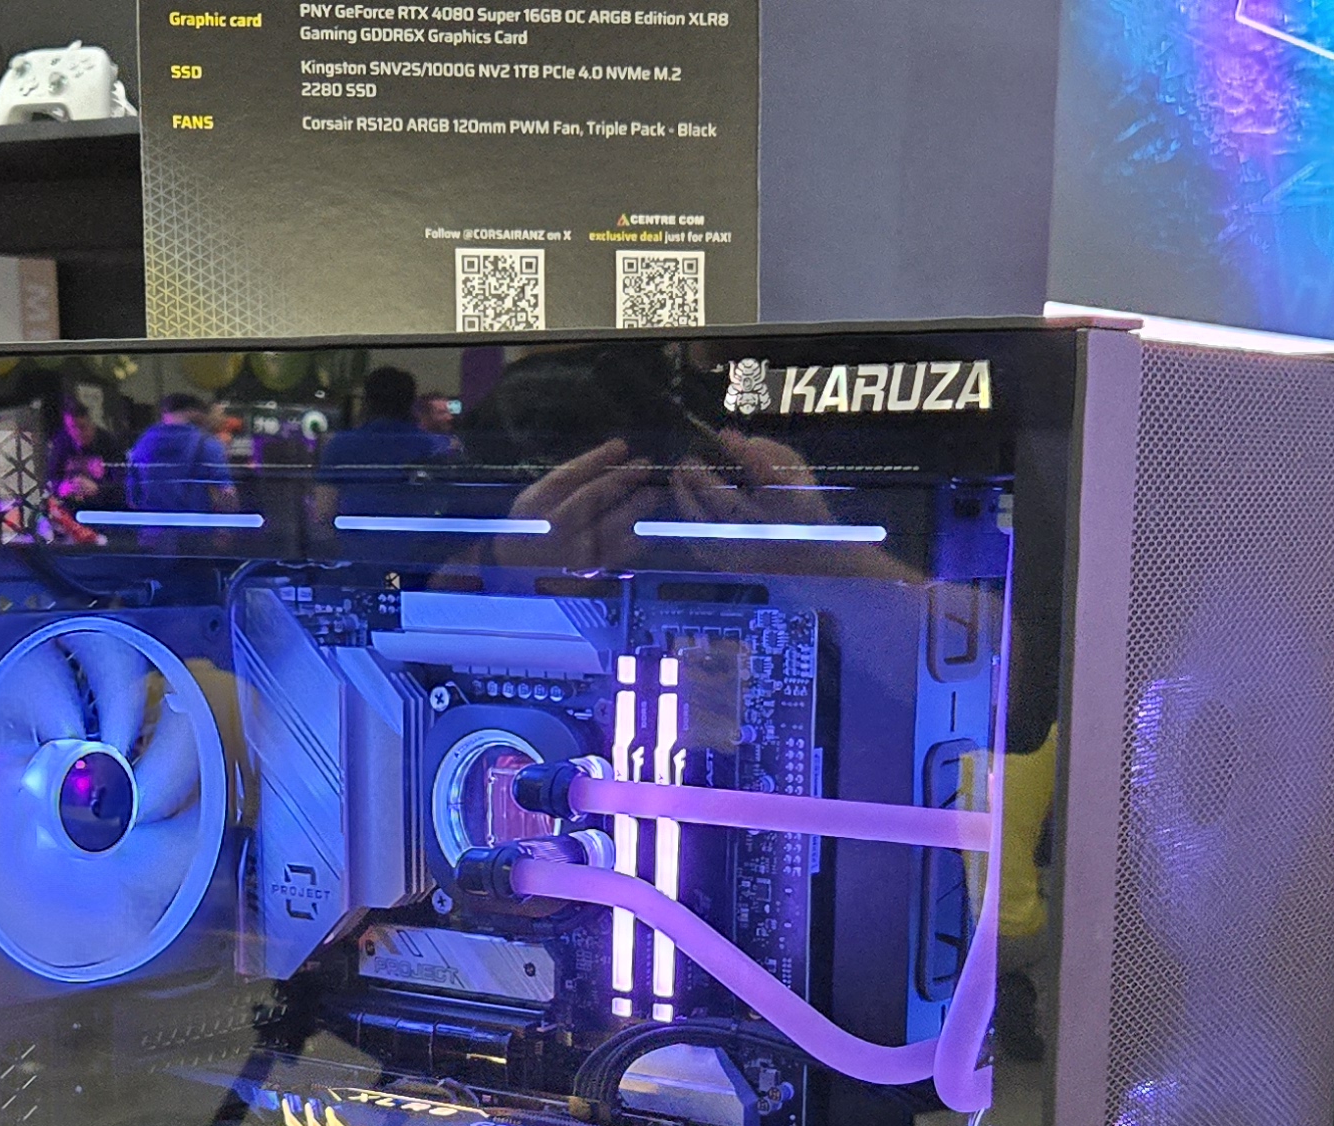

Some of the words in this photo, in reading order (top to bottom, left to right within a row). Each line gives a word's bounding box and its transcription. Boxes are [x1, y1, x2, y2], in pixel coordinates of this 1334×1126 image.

[169, 12, 226, 29] Graphic
[229, 13, 262, 28] card
[300, 4, 331, 18] PNY
[335, 5, 394, 20] GeForce
[398, 6, 428, 20] RTX
[431, 7, 474, 21] 4080
[477, 7, 520, 25] Super
[523, 8, 562, 23] 16GB
[565, 10, 585, 23] OC
[588, 10, 632, 24] ARGB
[634, 11, 685, 26] Edition
[688, 12, 729, 27] XLR8
[300, 26, 357, 44] Gaming
[360, 28, 425, 43] GDDR6X
[428, 28, 491, 46] Graphics
[495, 30, 528, 45] Card
[171, 65, 202, 79] SSD
[301, 60, 367, 79] Kingston
[369, 61, 475, 78] SNV2S/1000G
[478, 64, 510, 78] NV2
[513, 65, 539, 79] 1TB
[542, 65, 575, 80] PCIe
[578, 66, 603, 80] 4.0
[606, 66, 651, 81] NVMe
[654, 67, 682, 82] M.2
[301, 83, 343, 97] 2280
[346, 84, 377, 98] SSD
[172, 115, 214, 130] FANS
[302, 116, 353, 131] Corsair
[357, 117, 403, 132] RS120
[407, 118, 450, 133] ARGB
[453, 119, 506, 134] 120mm
[509, 121, 549, 135] PWM
[554, 121, 584, 137] Fan,
[587, 121, 627, 138] Triple
[631, 122, 666, 137] Pack
[677, 123, 717, 138] Black
[630, 215, 675, 226] CENTRE
[678, 215, 704, 226] COM
[425, 228, 461, 240] Follow
[547, 231, 561, 241] on
[563, 230, 572, 241] X
[589, 231, 637, 242] exclusive
[639, 231, 663, 242] deal
[664, 232, 685, 244] just
[687, 232, 703, 243] for
[705, 232, 732, 243] PAX!
[780, 360, 991, 414] KARUZA
[271, 884, 331, 900] PROJECT
[374, 957, 459, 986] PROJECT
